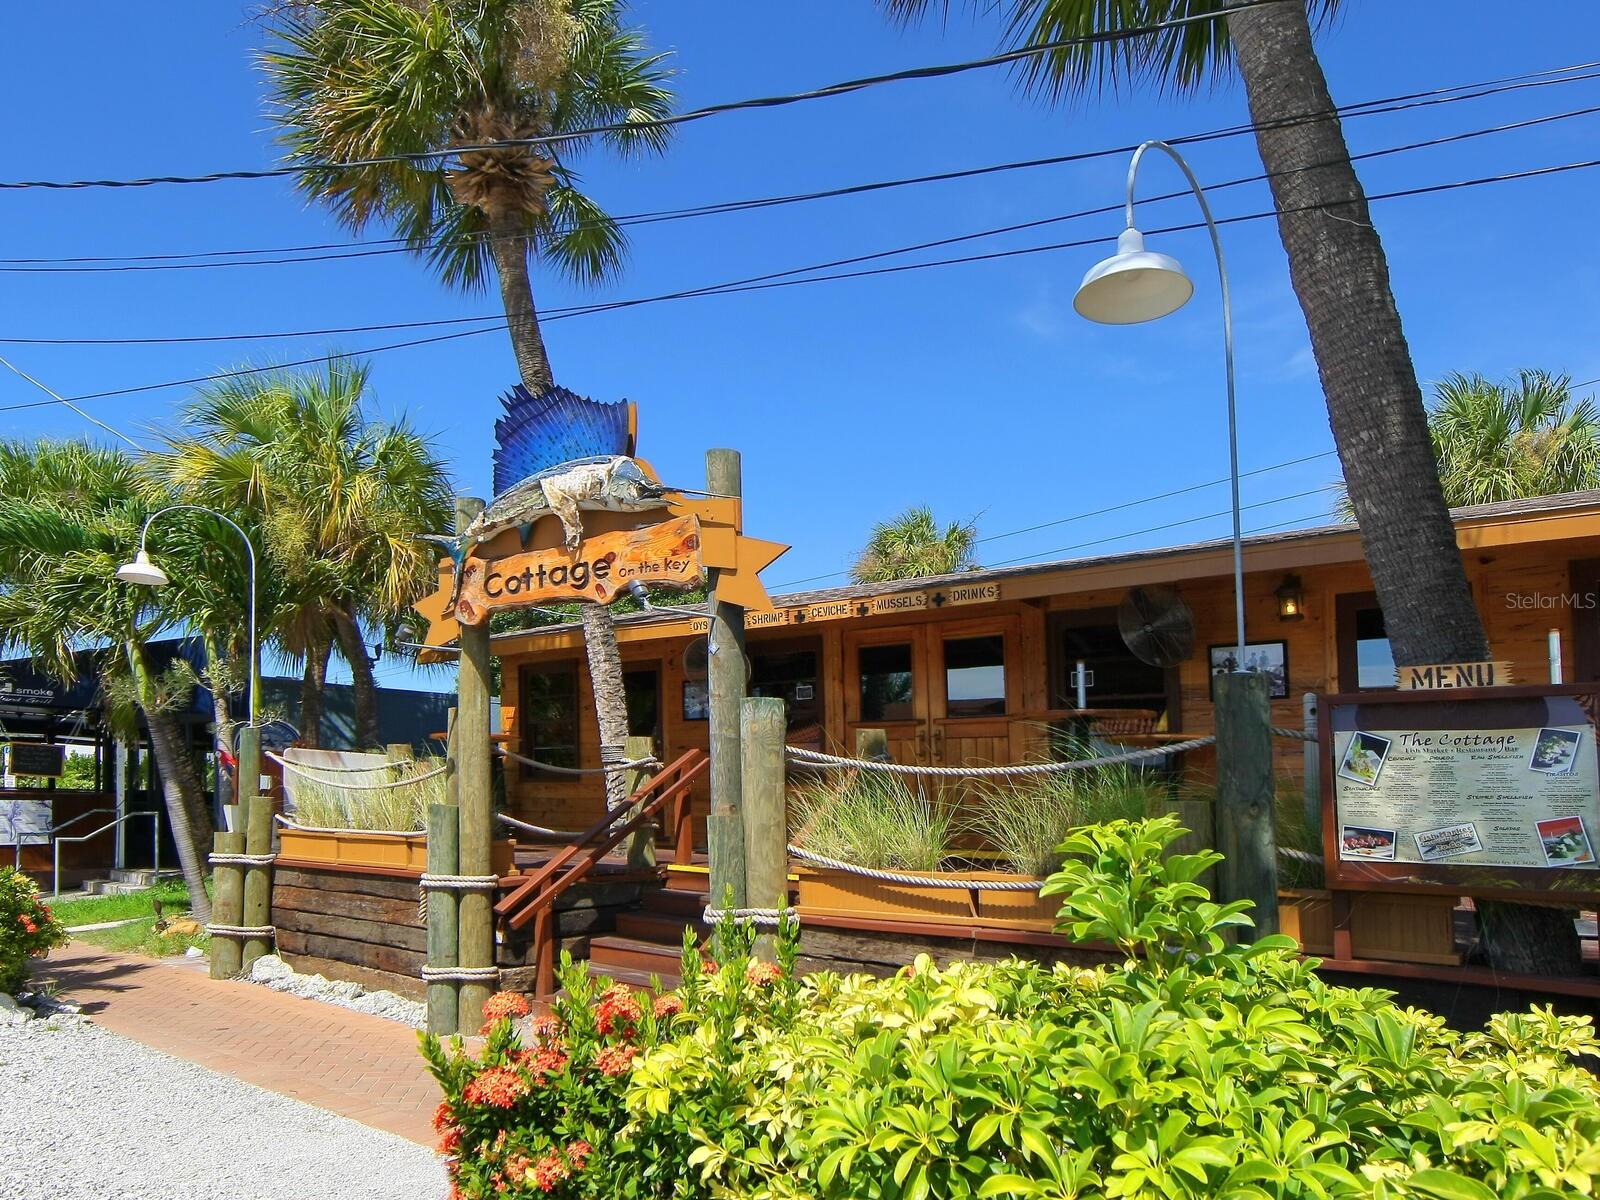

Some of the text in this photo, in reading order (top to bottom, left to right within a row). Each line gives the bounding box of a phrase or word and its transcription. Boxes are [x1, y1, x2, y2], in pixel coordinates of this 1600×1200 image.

[484, 557, 612, 598] Cottage
[618, 567, 635, 578] On
[638, 561, 659, 575] the
[952, 586, 995, 601] DRINKS
[876, 594, 923, 611] MUSSELS
[751, 611, 784, 625] SHRIMP
[811, 605, 849, 619] CEVICHE
[1411, 663, 1495, 690] MENU
[16, 688, 54, 696] smoke
[1400, 732, 1516, 754] The Cottage
